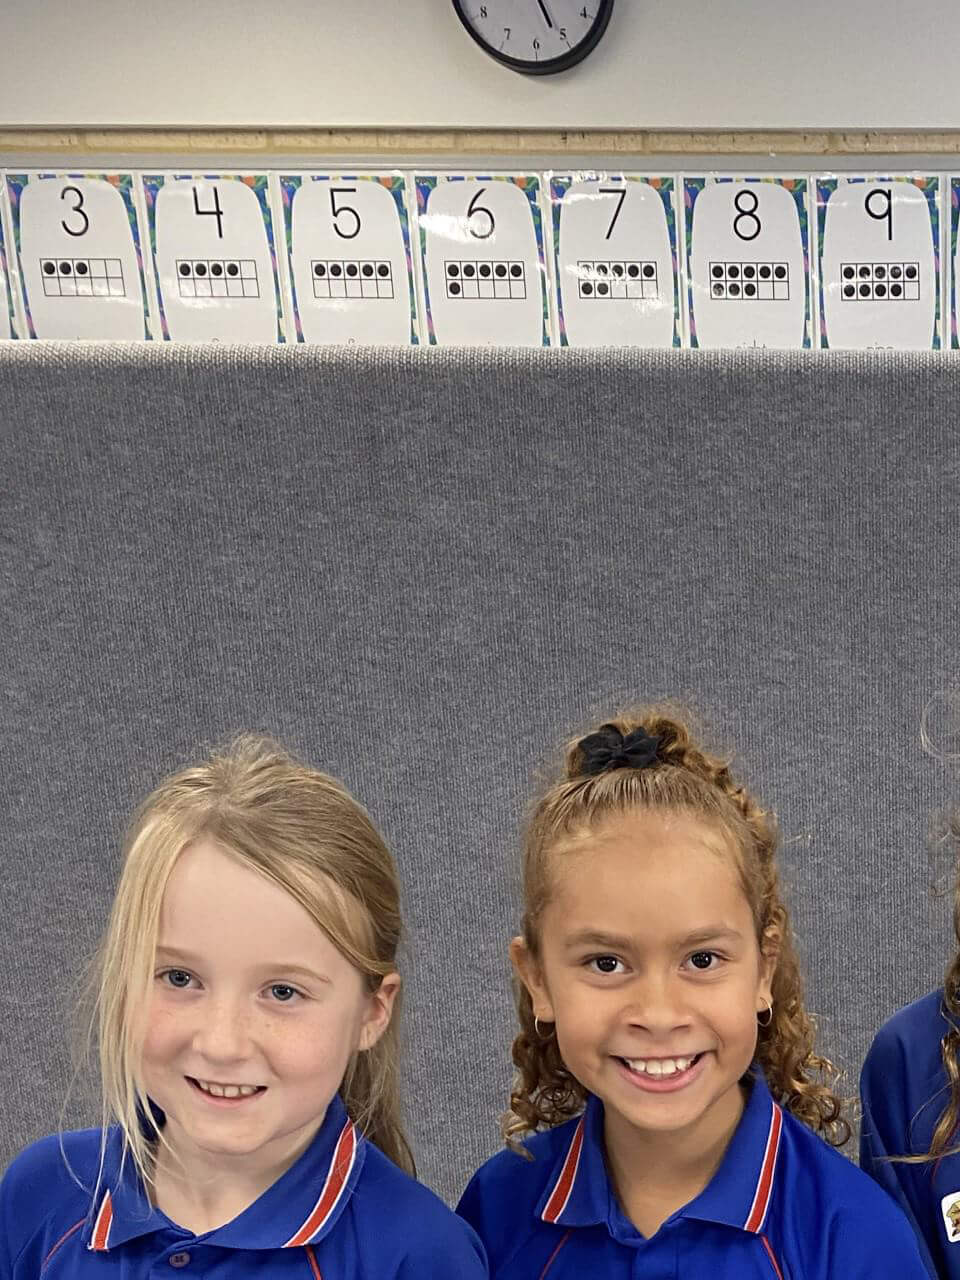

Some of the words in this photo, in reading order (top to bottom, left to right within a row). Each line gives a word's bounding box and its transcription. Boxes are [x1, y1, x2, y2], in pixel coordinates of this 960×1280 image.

[480, 6, 488, 18] 8
[503, 28, 512, 40] 7
[559, 28, 567, 40] 5
[580, 6, 588, 18] 4
[532, 38, 540, 50] 6
[60, 186, 90, 237] 3
[192, 186, 224, 239] 4
[329, 188, 361, 240] 5
[467, 188, 496, 240] 6
[599, 188, 627, 241] 7
[733, 189, 762, 241] 8
[864, 188, 893, 241] 9
